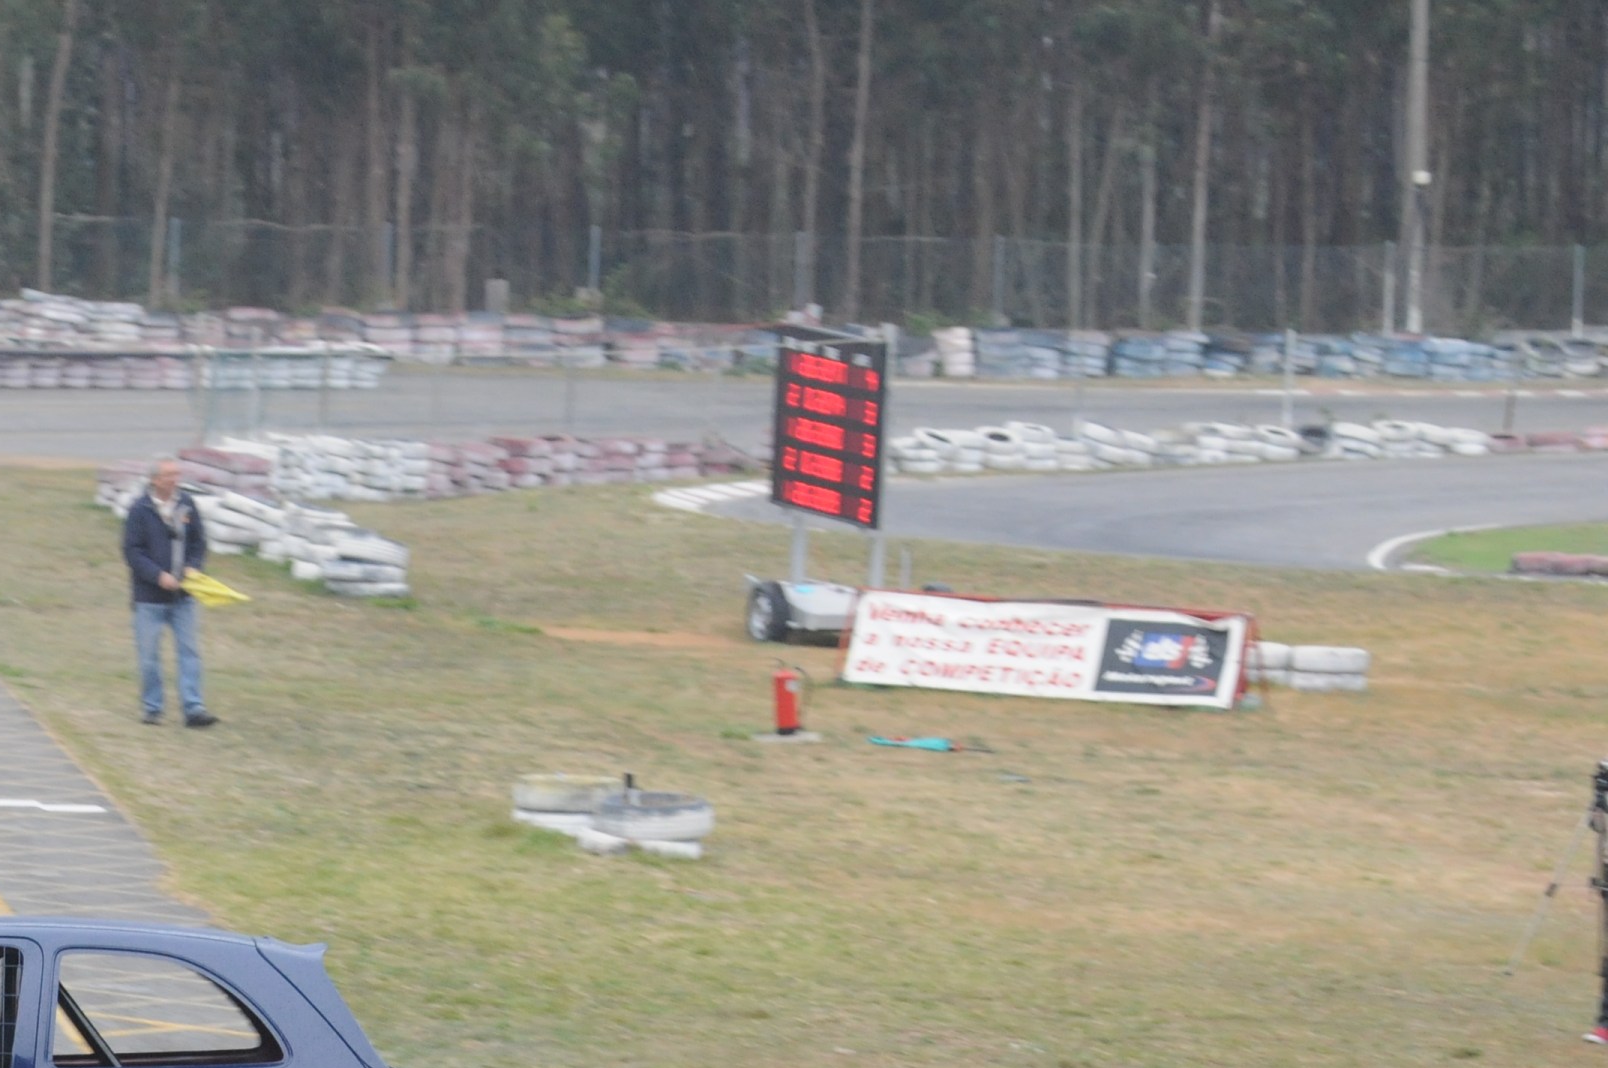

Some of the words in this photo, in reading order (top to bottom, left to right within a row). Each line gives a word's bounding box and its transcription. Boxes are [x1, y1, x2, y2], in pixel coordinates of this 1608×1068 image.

[867, 602, 946, 627] Venha
[958, 615, 1091, 637] conhecer
[862, 632, 881, 646] a
[891, 634, 973, 653] nossa
[987, 638, 1085, 661] EQUIPA
[854, 656, 886, 674] de
